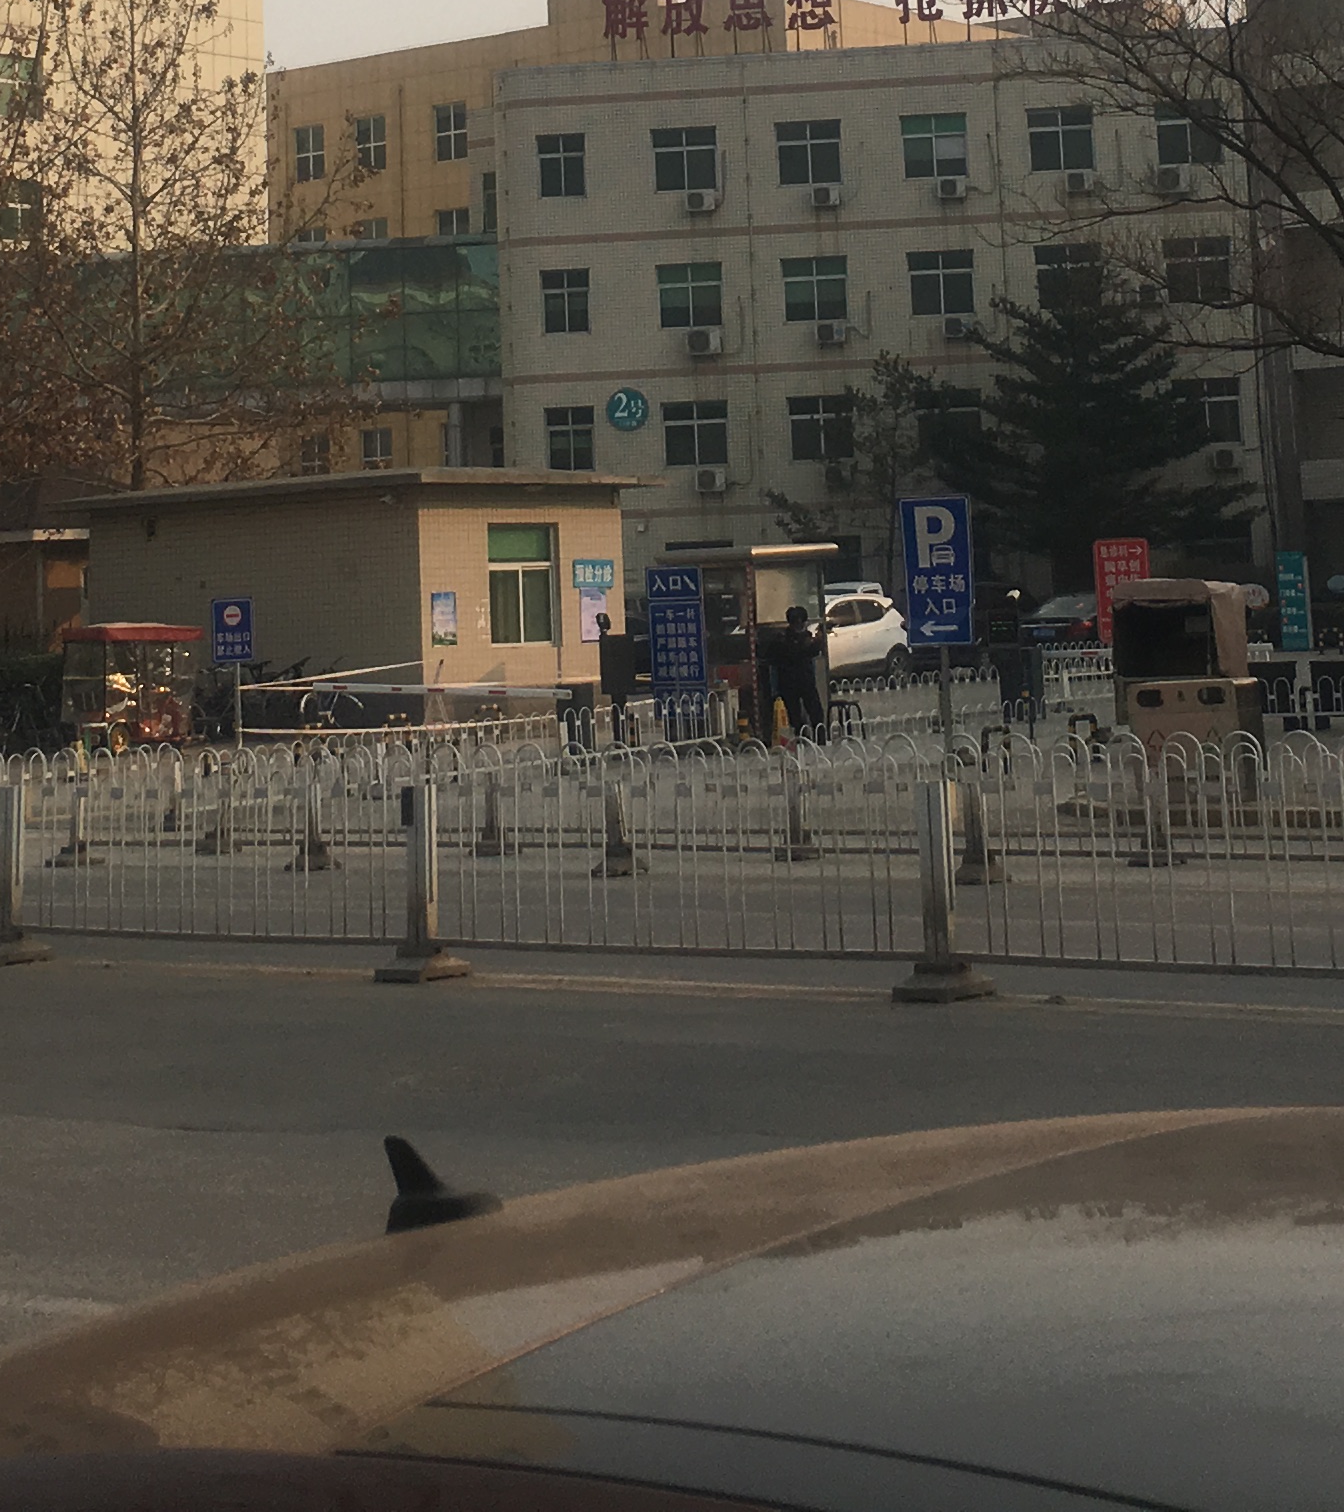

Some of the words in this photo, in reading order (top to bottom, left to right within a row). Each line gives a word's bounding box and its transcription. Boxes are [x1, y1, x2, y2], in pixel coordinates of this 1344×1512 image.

[913, 505, 956, 569] P
[652, 575, 682, 592] 入口
[912, 574, 966, 595] 停车场
[924, 597, 957, 616] 入口
